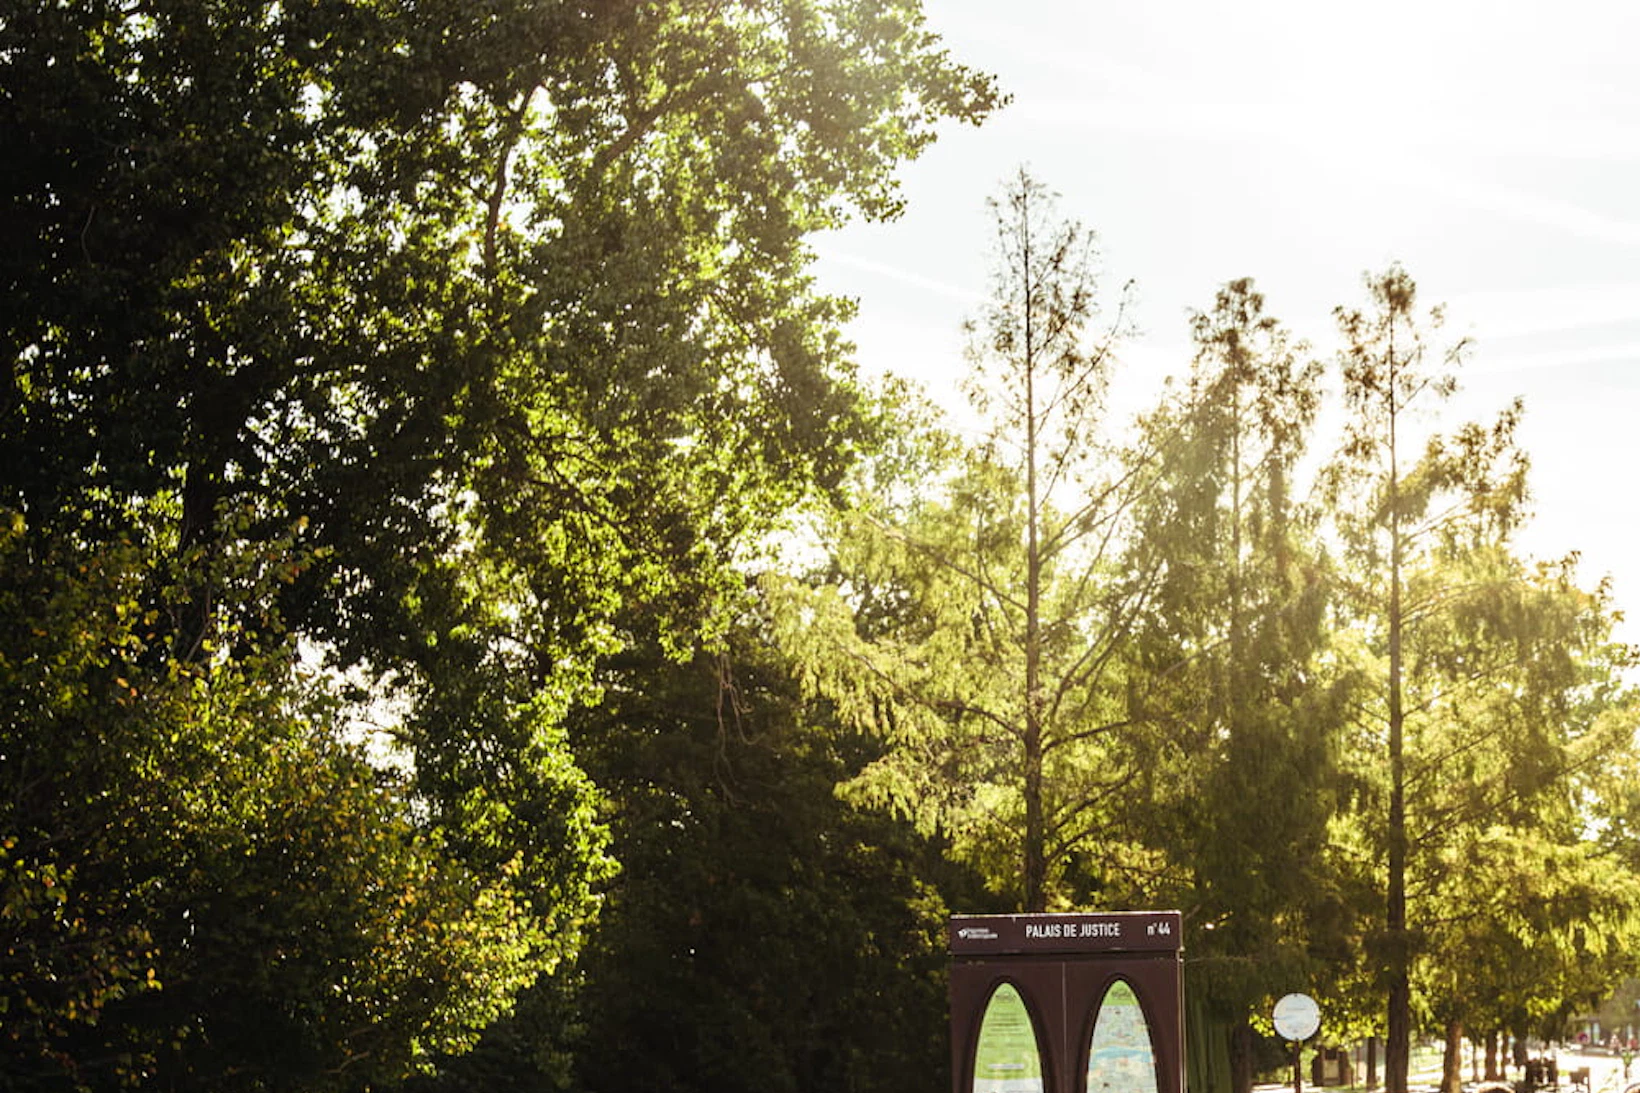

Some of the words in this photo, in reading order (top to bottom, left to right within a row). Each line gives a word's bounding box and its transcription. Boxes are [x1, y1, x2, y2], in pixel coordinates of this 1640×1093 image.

[1026, 924, 1060, 938] PALAIS
[1064, 924, 1076, 937] DE
[1079, 922, 1121, 937] JUSTICE
